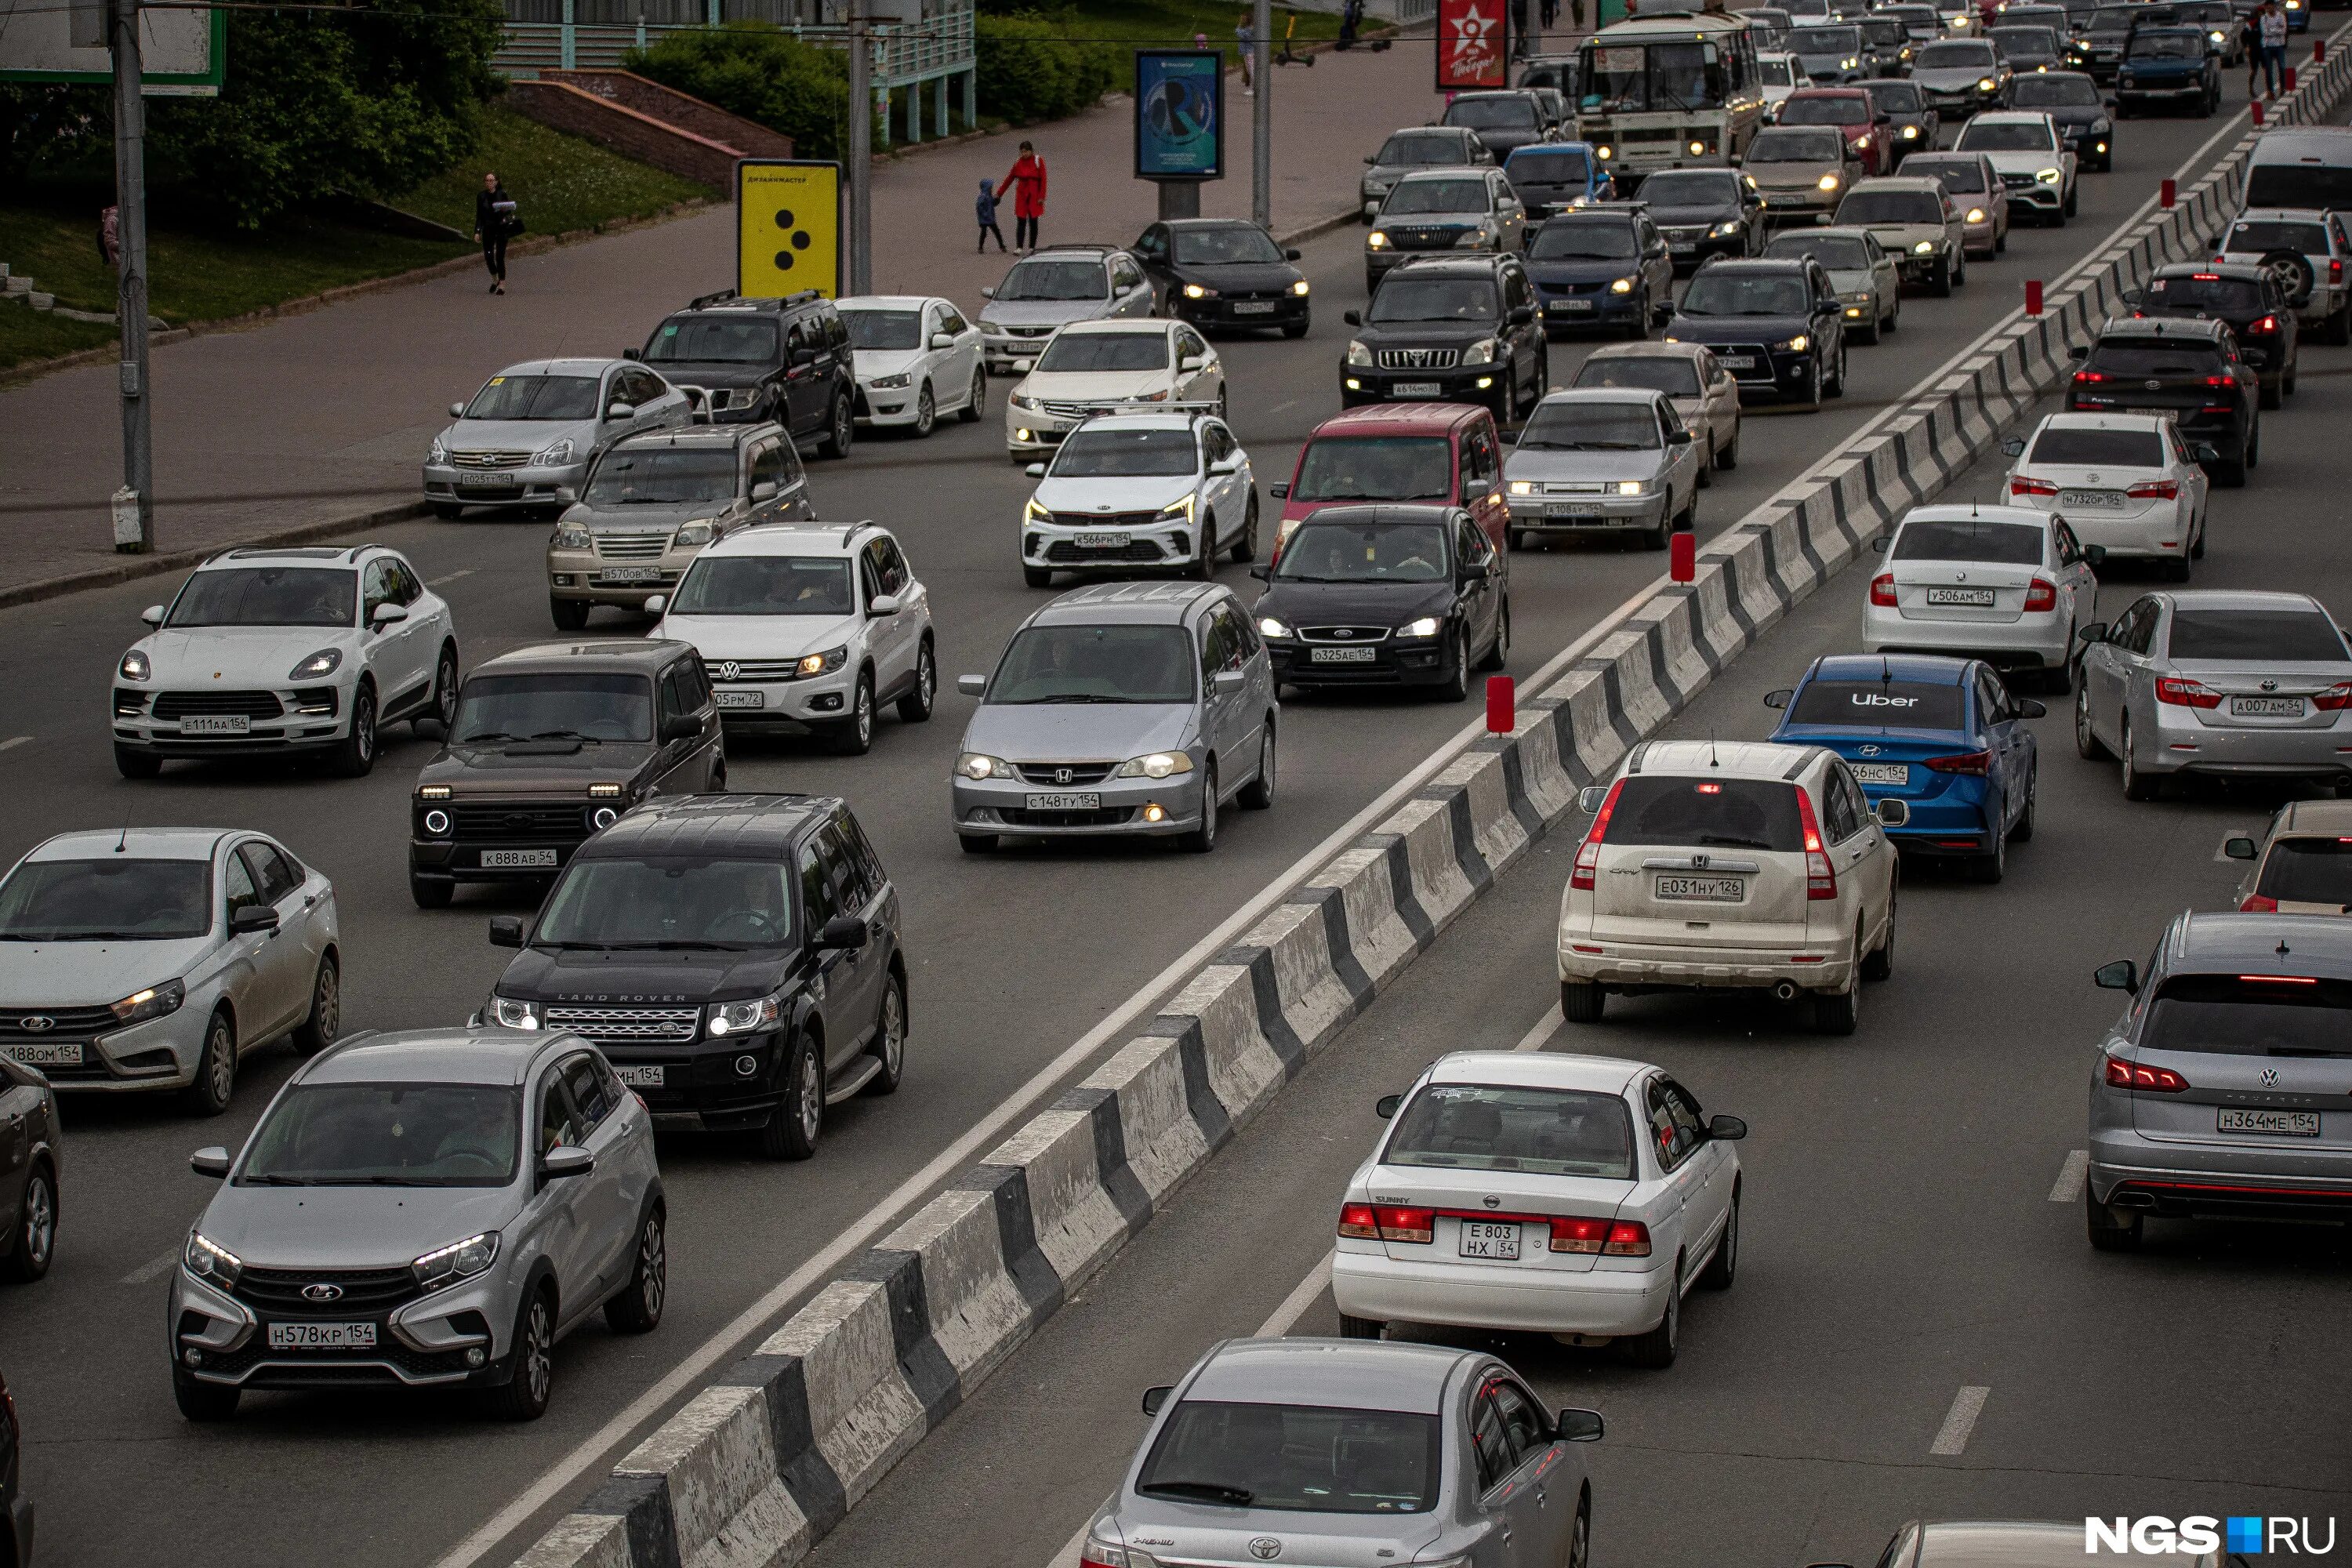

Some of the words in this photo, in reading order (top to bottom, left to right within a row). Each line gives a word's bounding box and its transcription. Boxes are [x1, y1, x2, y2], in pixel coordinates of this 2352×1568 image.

[465, 474, 496, 484] Е025ТТ
[1077, 535, 1113, 545] К566РН
[605, 568, 641, 579] В570ОВ
[643, 568, 658, 576] 154
[1933, 589, 1973, 601] У506АМ
[1974, 590, 1991, 600] 154
[1315, 650, 1356, 661] О325АЕ
[749, 694, 759, 702] 72
[1852, 693, 1918, 707] Uber
[2286, 699, 2299, 710] 54
[185, 718, 228, 730] Е111АА
[229, 718, 246, 728] 154
[1886, 766, 1906, 776] 154
[1030, 795, 1076, 808] С148ТУ
[1079, 794, 1098, 804] 154
[539, 851, 552, 861] 54
[1662, 879, 1715, 895] Е031НУ
[1719, 880, 1740, 892] 126
[57, 1046, 79, 1058] 154
[638, 1067, 661, 1080] 154
[2223, 1112, 2287, 1130] Н364МЕ
[2291, 1114, 2316, 1128] 154
[1375, 1196, 1410, 1204] SUNNY
[1467, 1241, 1489, 1255] НХ
[1499, 1242, 1514, 1254] 54
[274, 1326, 342, 1343] Н578КР
[347, 1325, 372, 1338] 154
